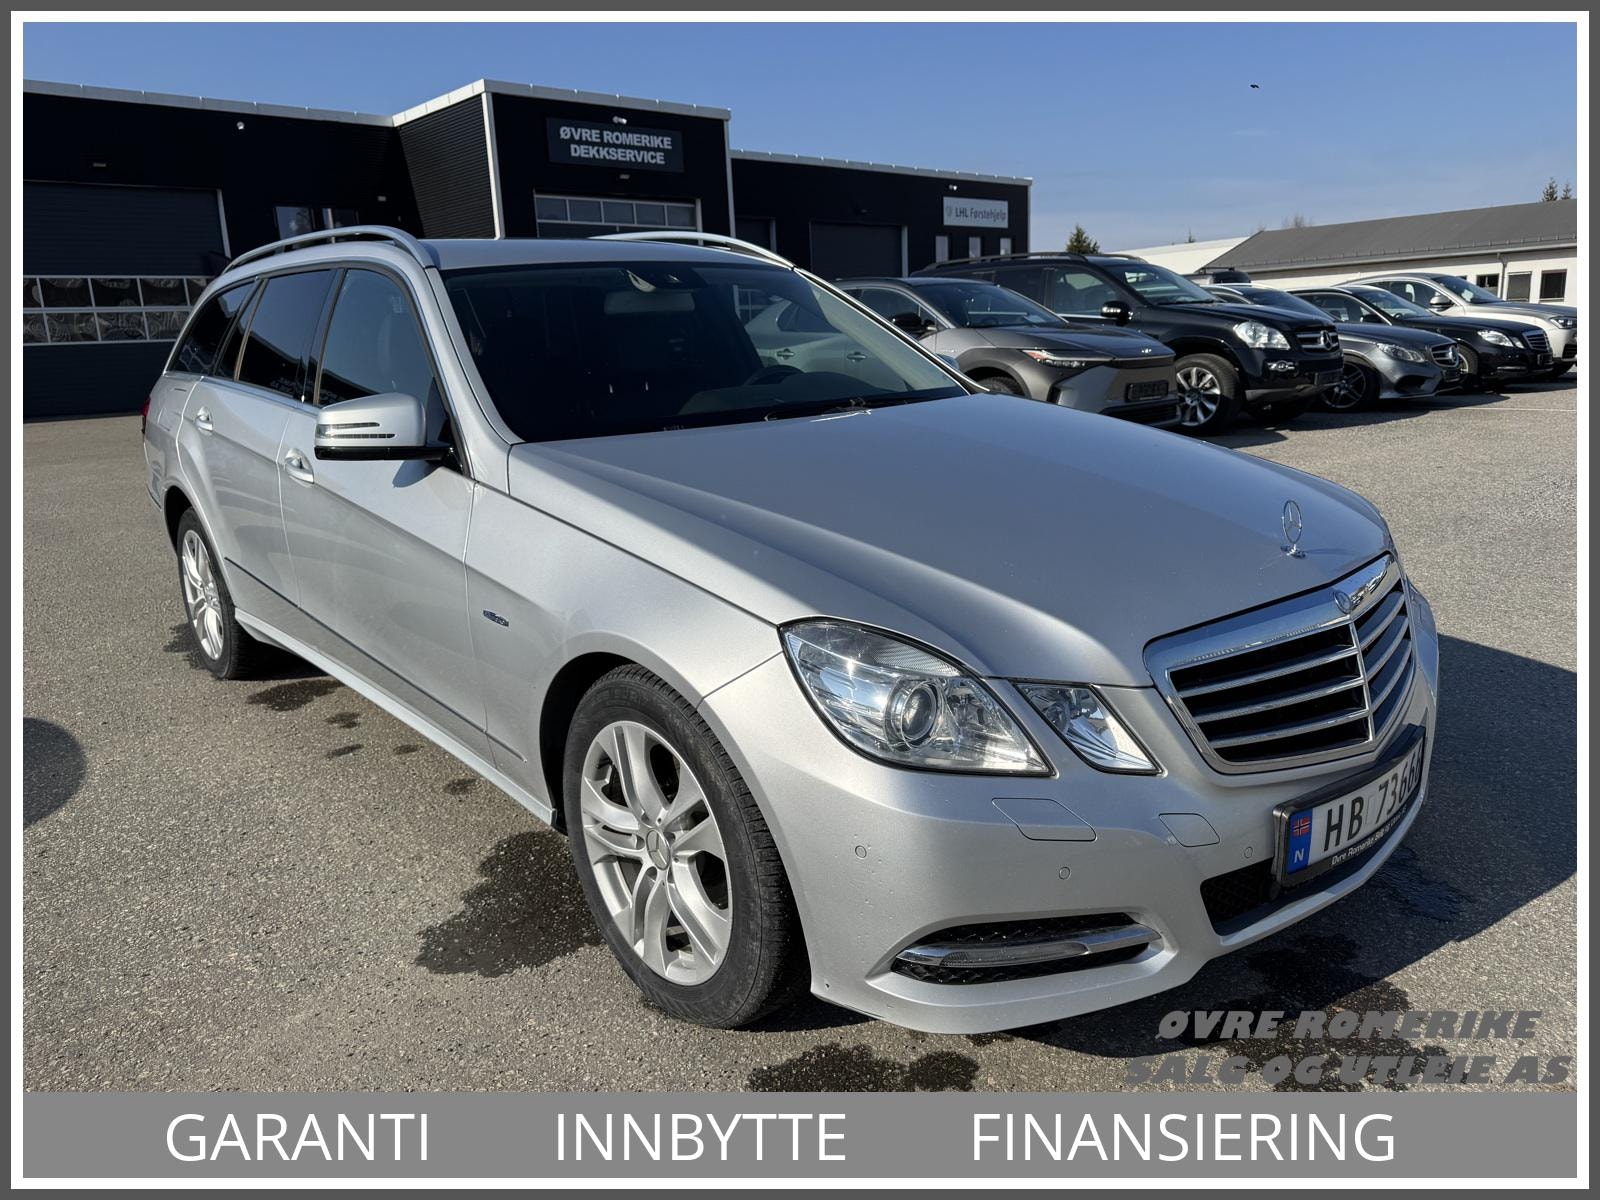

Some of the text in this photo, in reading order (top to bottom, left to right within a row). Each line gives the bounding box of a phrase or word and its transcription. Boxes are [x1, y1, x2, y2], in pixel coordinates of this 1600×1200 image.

[560, 126, 672, 149] ØVRE ROMERIKE
[570, 144, 665, 164] DEKKSERVICE
[955, 207, 969, 218] LHL
[1324, 796, 1365, 852] HB
[1294, 849, 1305, 863] N
